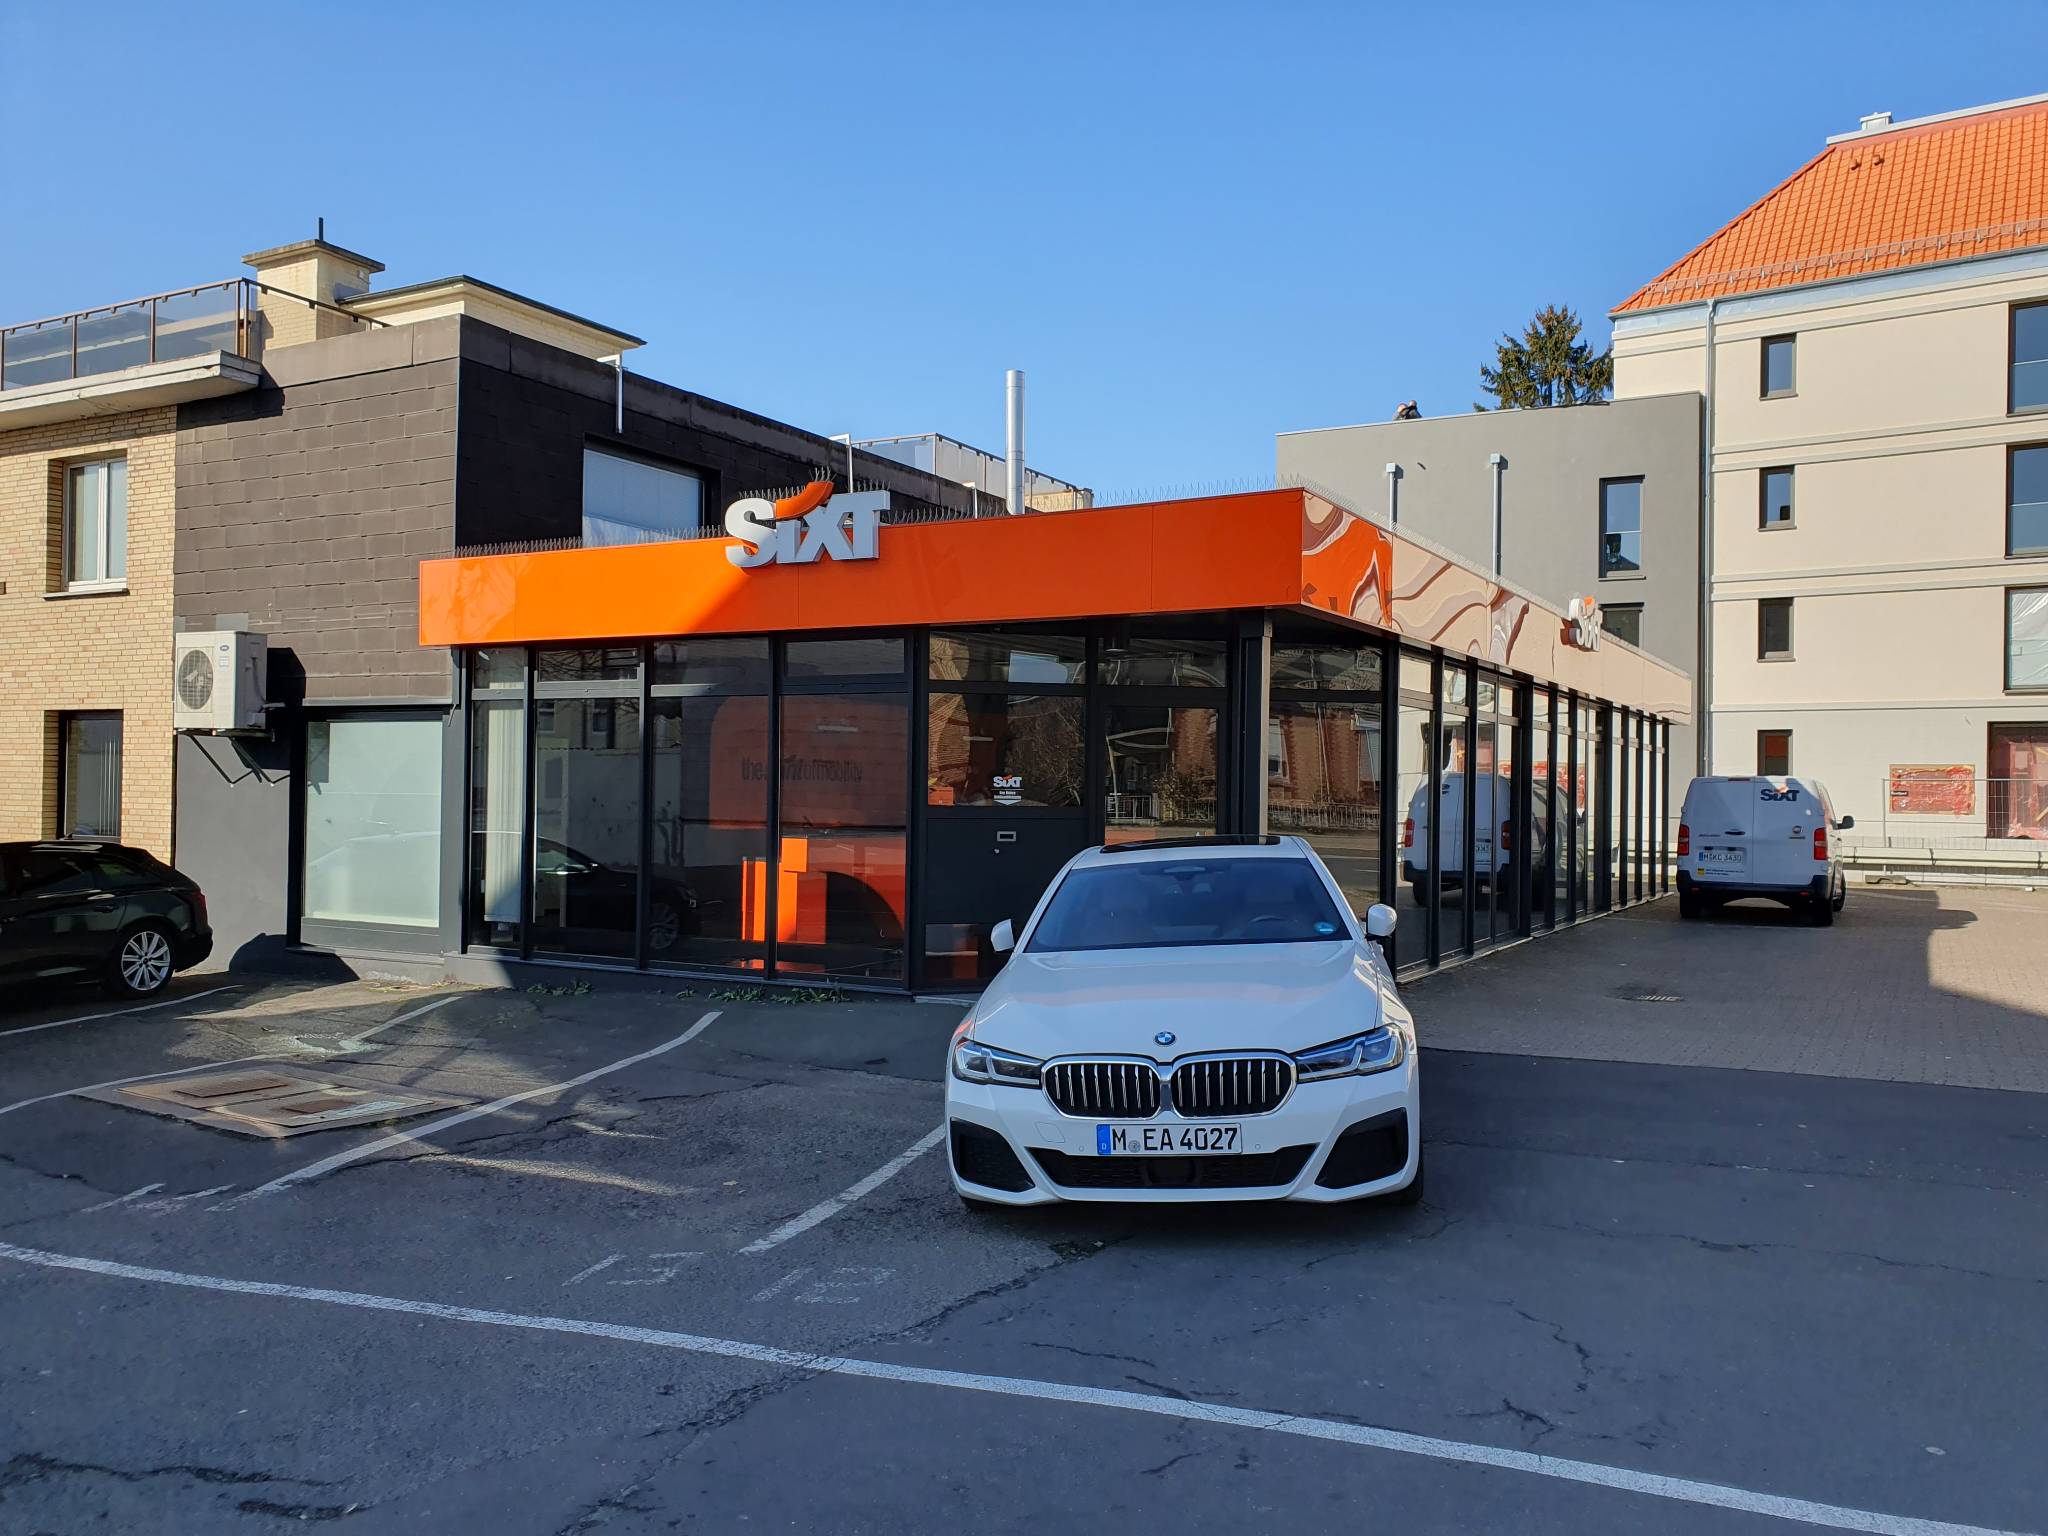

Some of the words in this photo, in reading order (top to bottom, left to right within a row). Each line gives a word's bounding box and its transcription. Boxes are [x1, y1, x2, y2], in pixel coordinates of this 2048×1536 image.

[1112, 1128, 1127, 1150] M
[1143, 1128, 1173, 1150] EA
[1180, 1127, 1237, 1150] 4027
